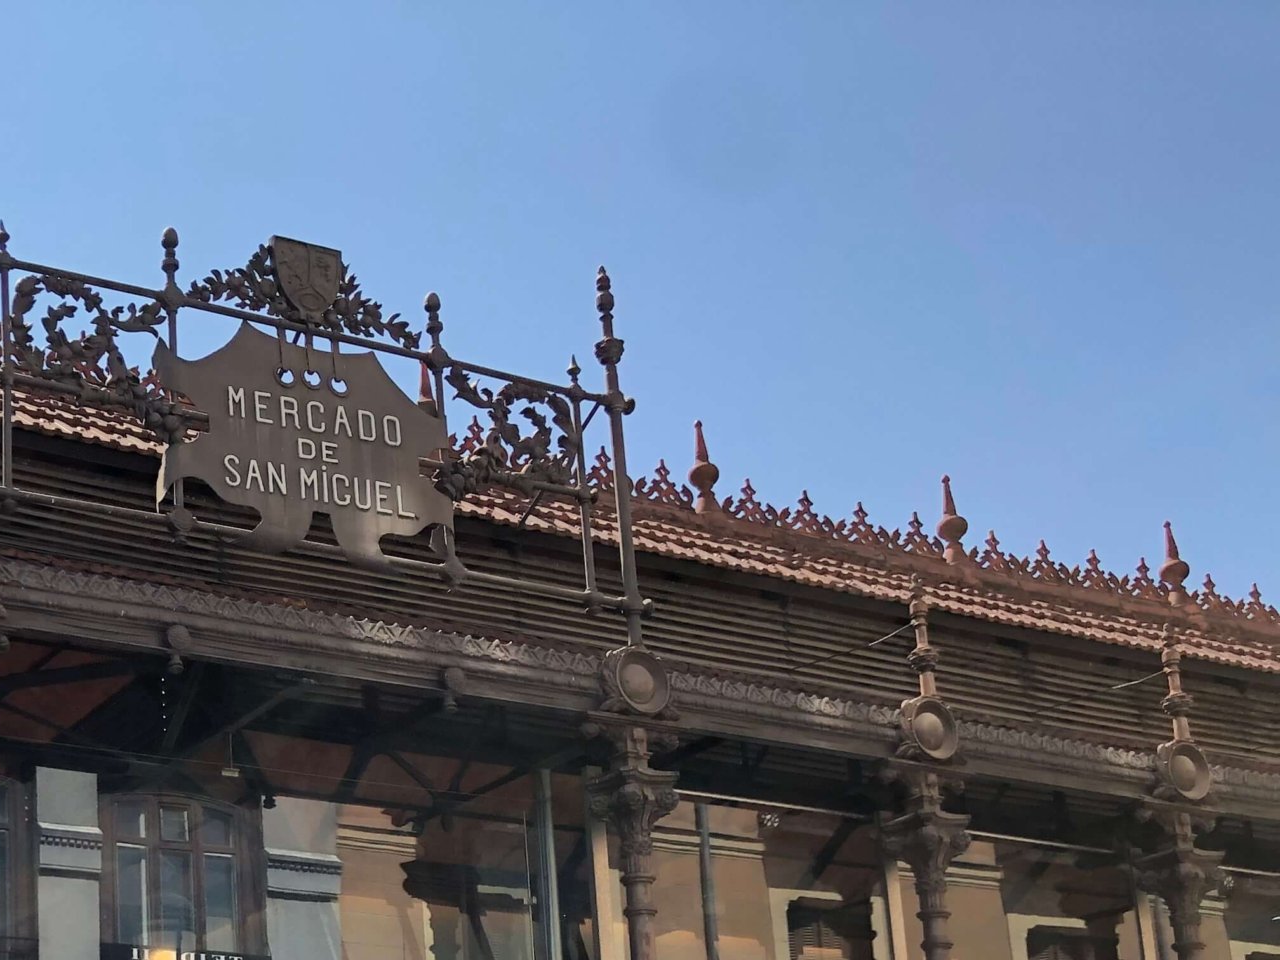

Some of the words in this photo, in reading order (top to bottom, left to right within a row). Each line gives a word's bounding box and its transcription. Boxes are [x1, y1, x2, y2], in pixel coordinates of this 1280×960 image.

[227, 385, 402, 447] MERCADO
[297, 437, 339, 464] DE
[224, 454, 287, 495] SAN
